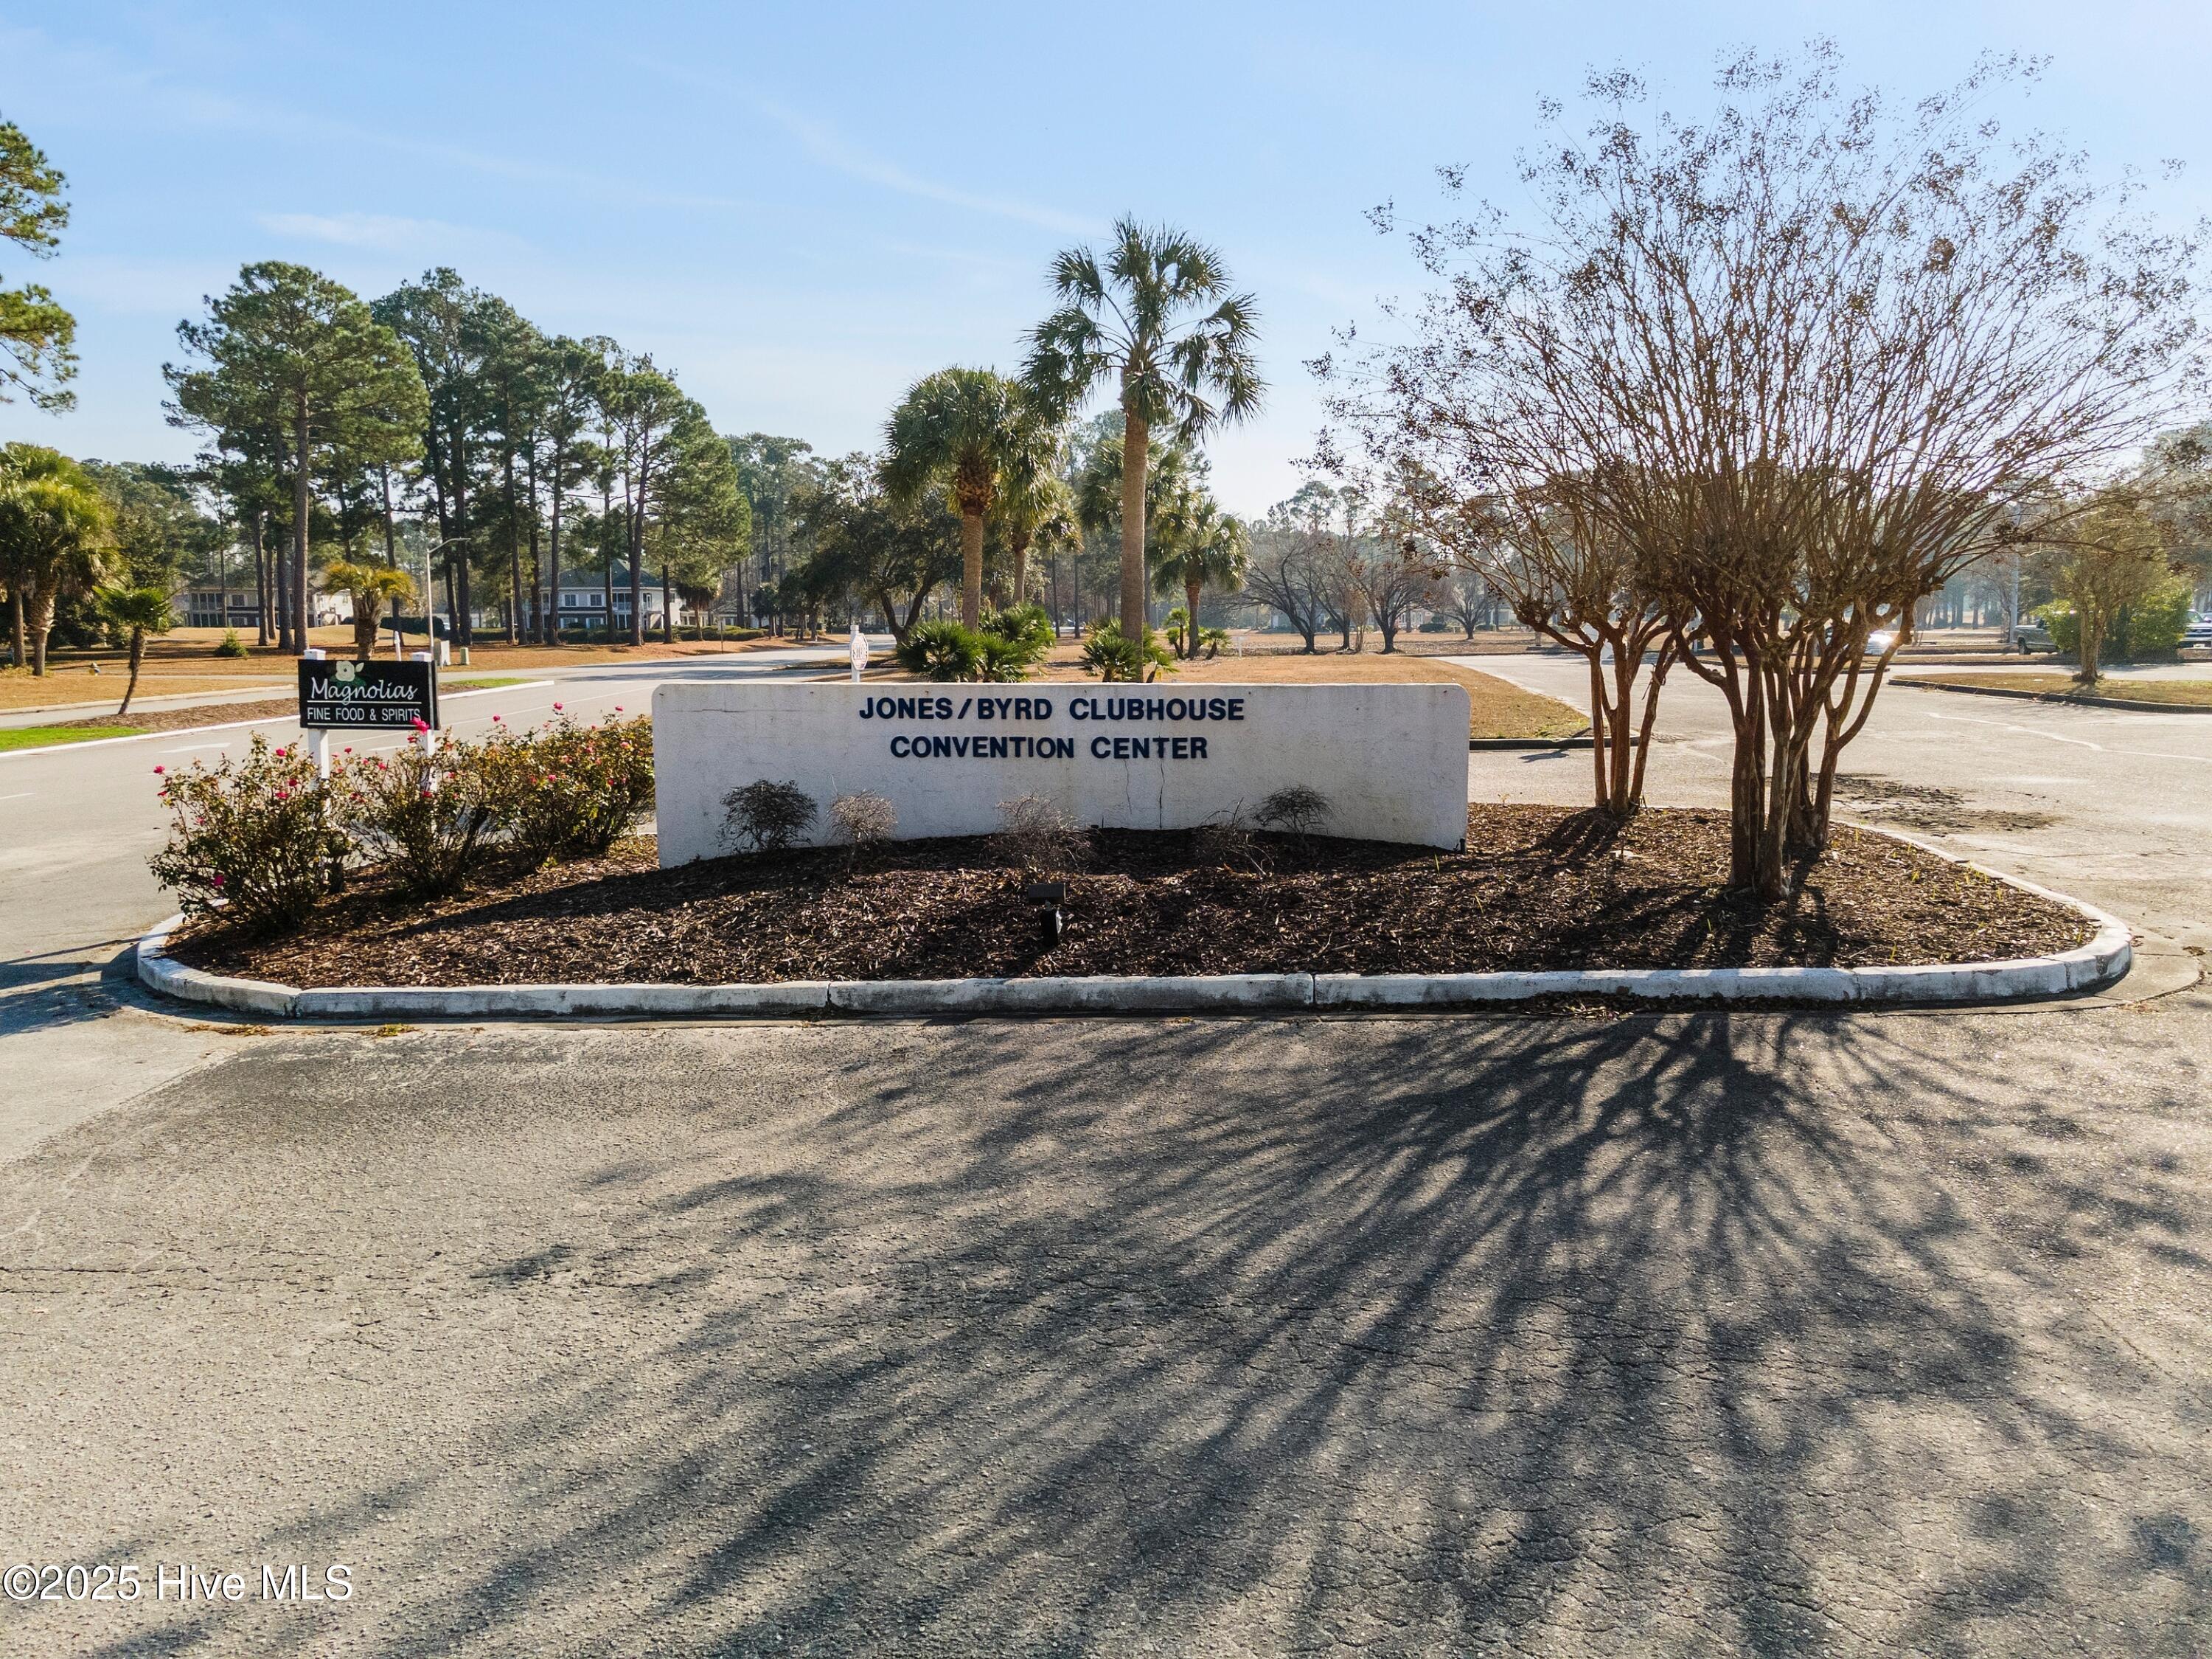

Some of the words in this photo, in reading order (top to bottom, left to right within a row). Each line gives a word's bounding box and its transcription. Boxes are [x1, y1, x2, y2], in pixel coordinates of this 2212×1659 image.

[311, 677, 417, 705] Magnolias
[307, 707, 330, 720] FINE
[335, 708, 365, 721] FOOD
[369, 709, 377, 721] &
[381, 709, 420, 721] SPIRITS
[859, 698, 1052, 720] JONES/BYRD
[1069, 698, 1245, 720] CLUBHOUSE
[890, 736, 1074, 758] CONVENTION
[1091, 737, 1208, 759] CENTER
